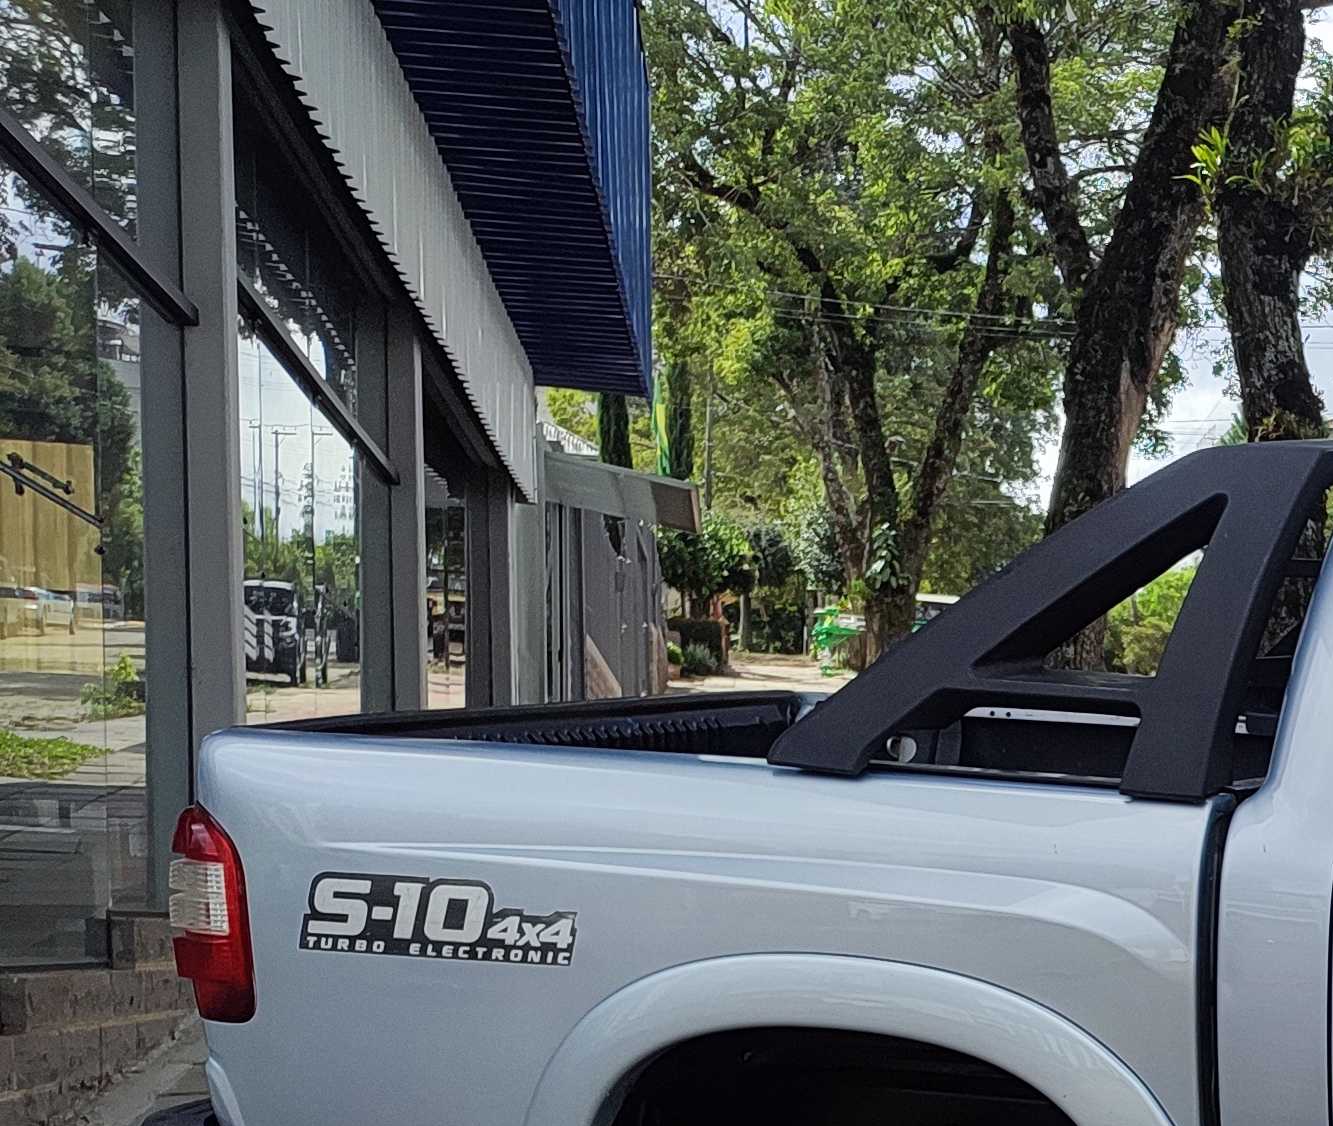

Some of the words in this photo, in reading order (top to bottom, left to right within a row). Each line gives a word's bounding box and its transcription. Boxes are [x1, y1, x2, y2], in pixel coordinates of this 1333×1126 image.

[307, 877, 490, 944] S-10
[486, 914, 574, 948] 4x4
[305, 935, 386, 953] TURBO
[409, 943, 571, 965] ELECTRONIC
